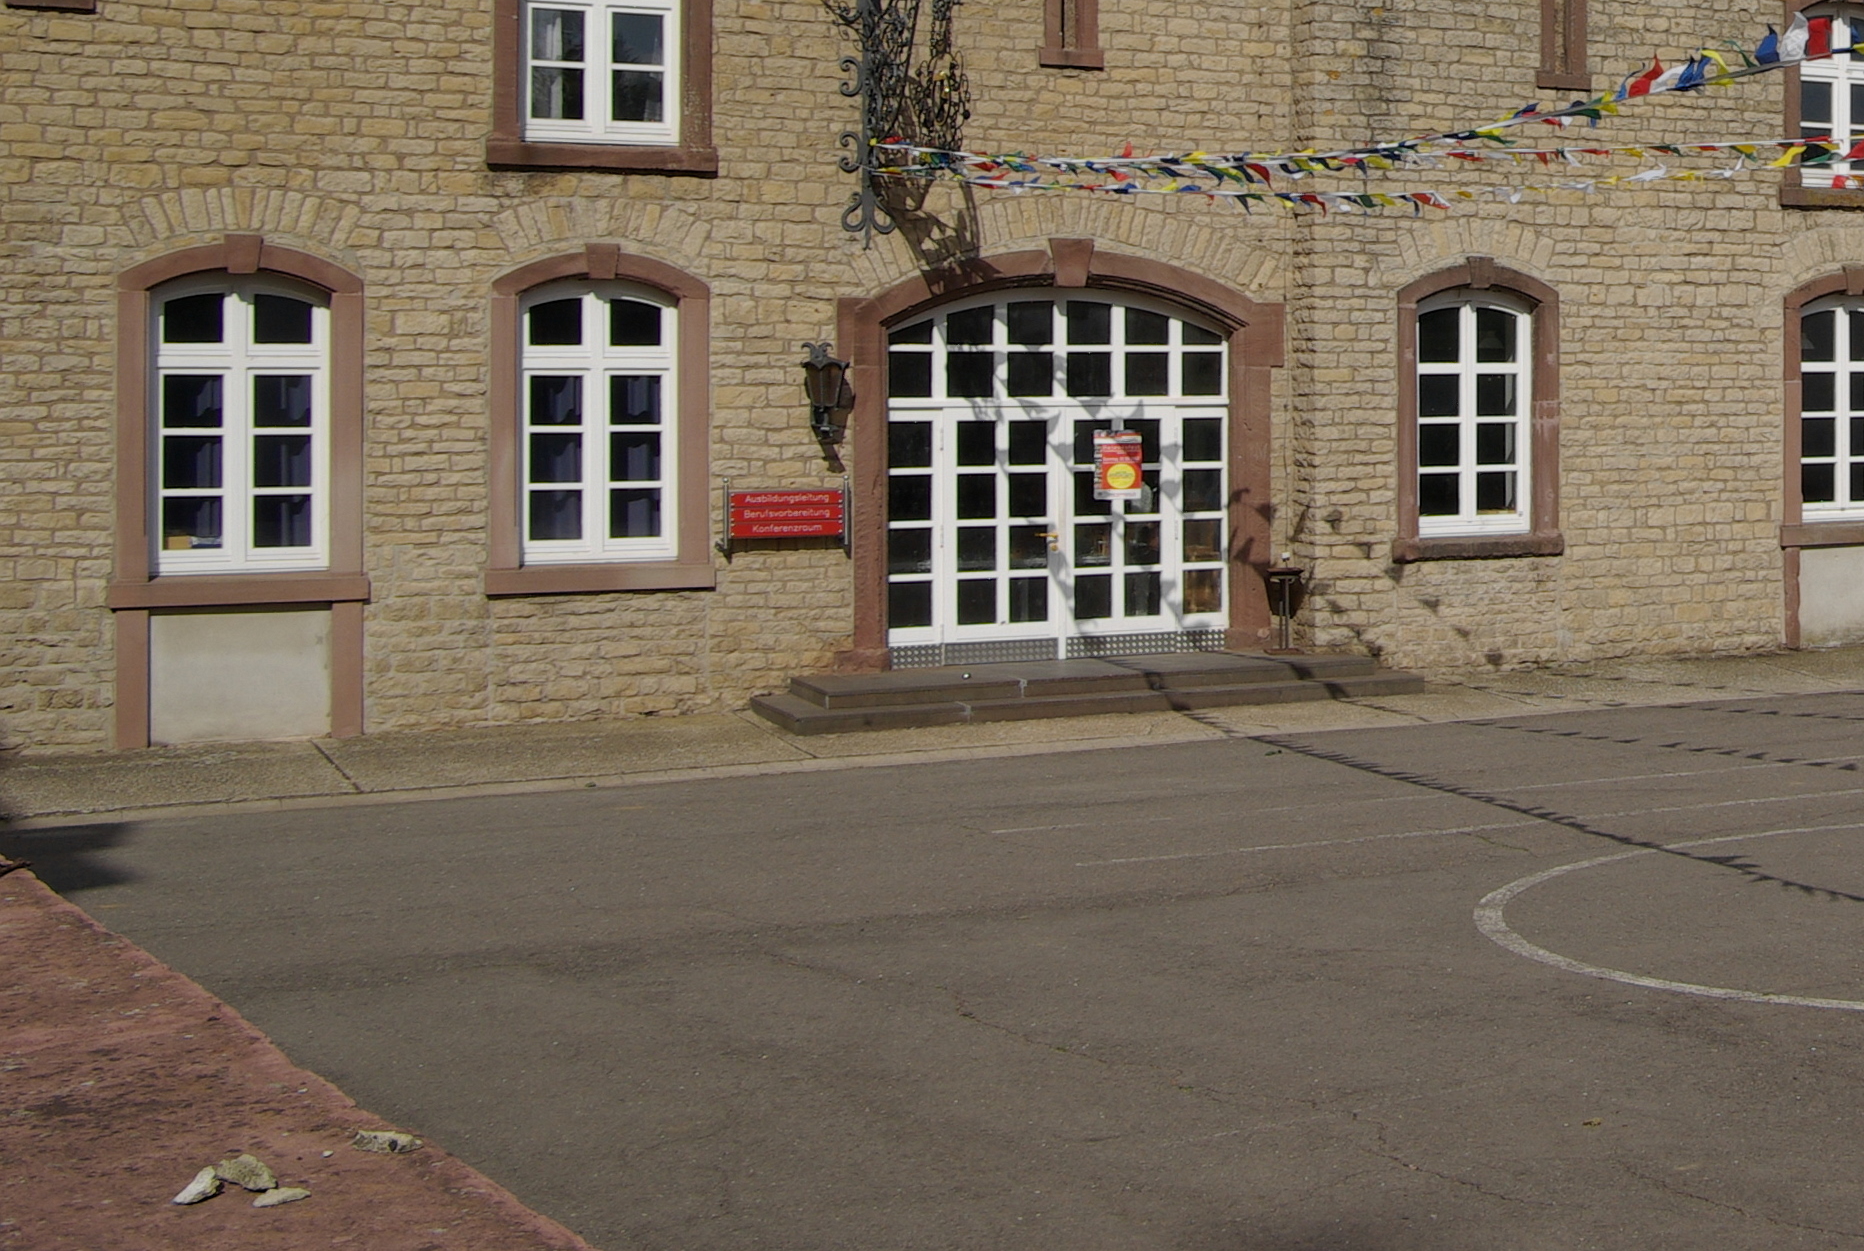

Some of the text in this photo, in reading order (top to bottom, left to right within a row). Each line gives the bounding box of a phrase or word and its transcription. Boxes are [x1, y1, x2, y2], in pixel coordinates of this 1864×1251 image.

[745, 494, 829, 504] Ausbildungsleitung
[744, 508, 830, 518] Berufsvorbereitung
[752, 524, 822, 533] Konferenzraum
